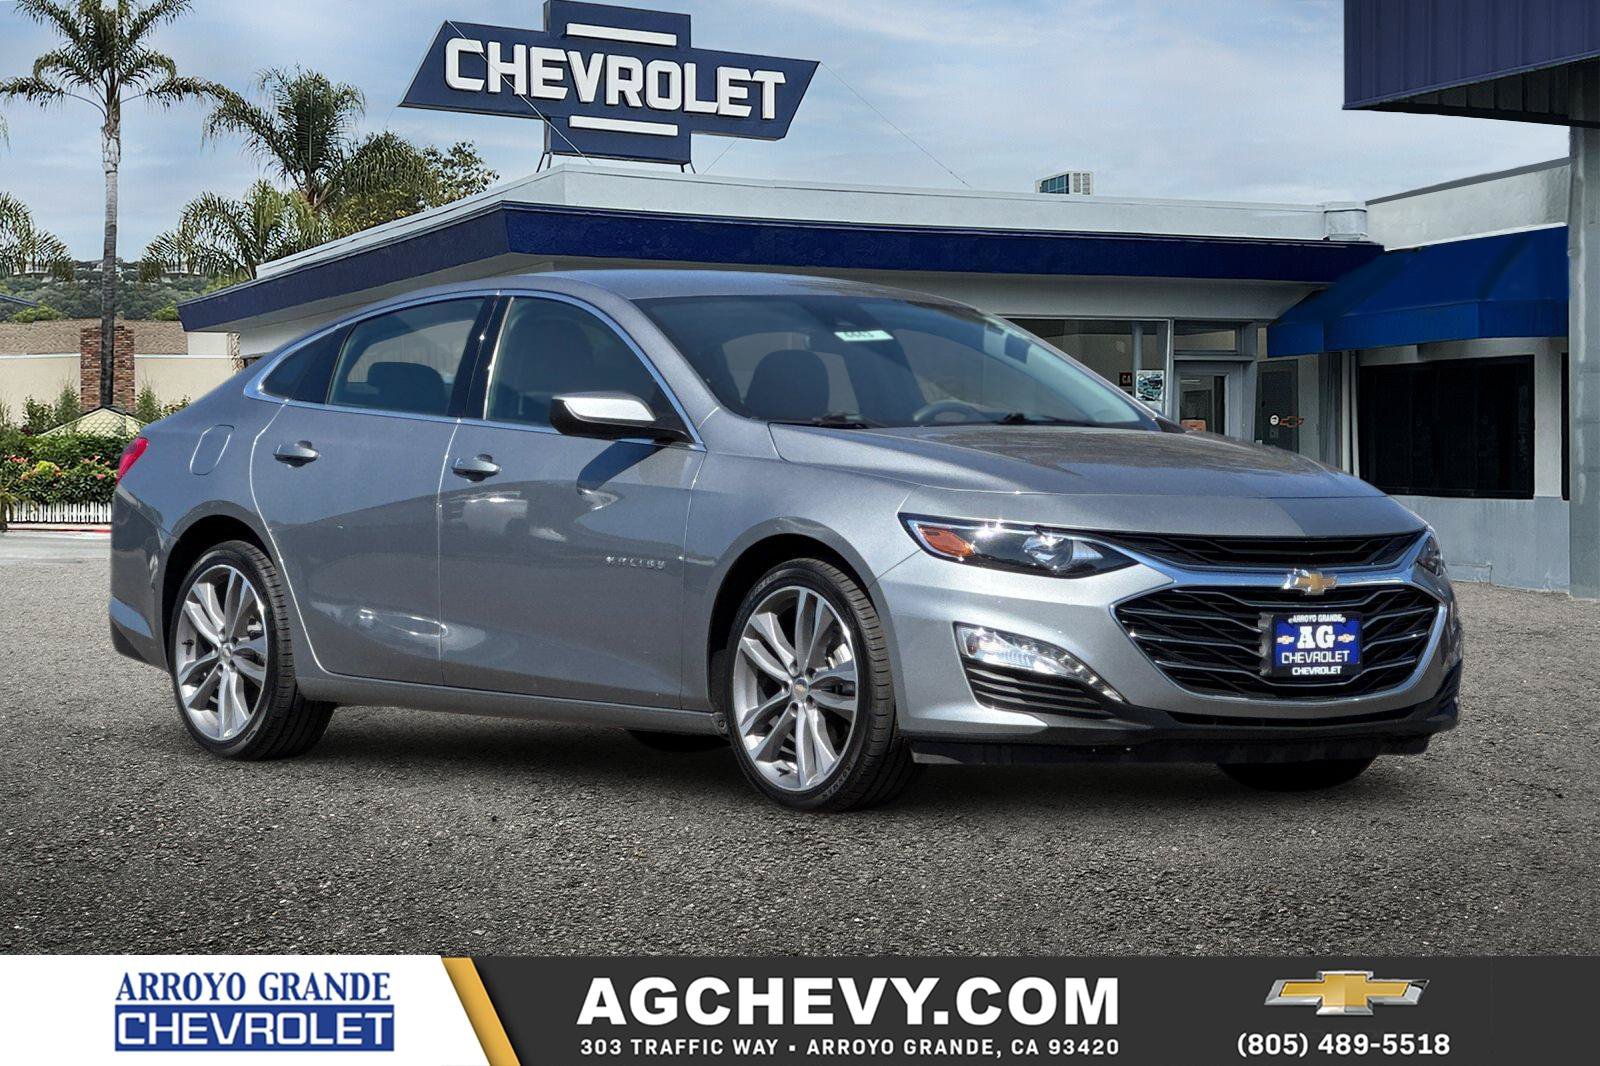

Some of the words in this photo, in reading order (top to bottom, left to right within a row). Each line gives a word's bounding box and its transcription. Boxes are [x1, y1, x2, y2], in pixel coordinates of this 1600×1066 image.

[445, 38, 786, 119] CHEVROLET
[1292, 614, 1317, 623] ARROYO
[1317, 613, 1343, 623] GRANDE
[1297, 625, 1336, 649] AG
[1281, 650, 1350, 664] CHEVROLET
[1292, 665, 1342, 676] CHEVROLET
